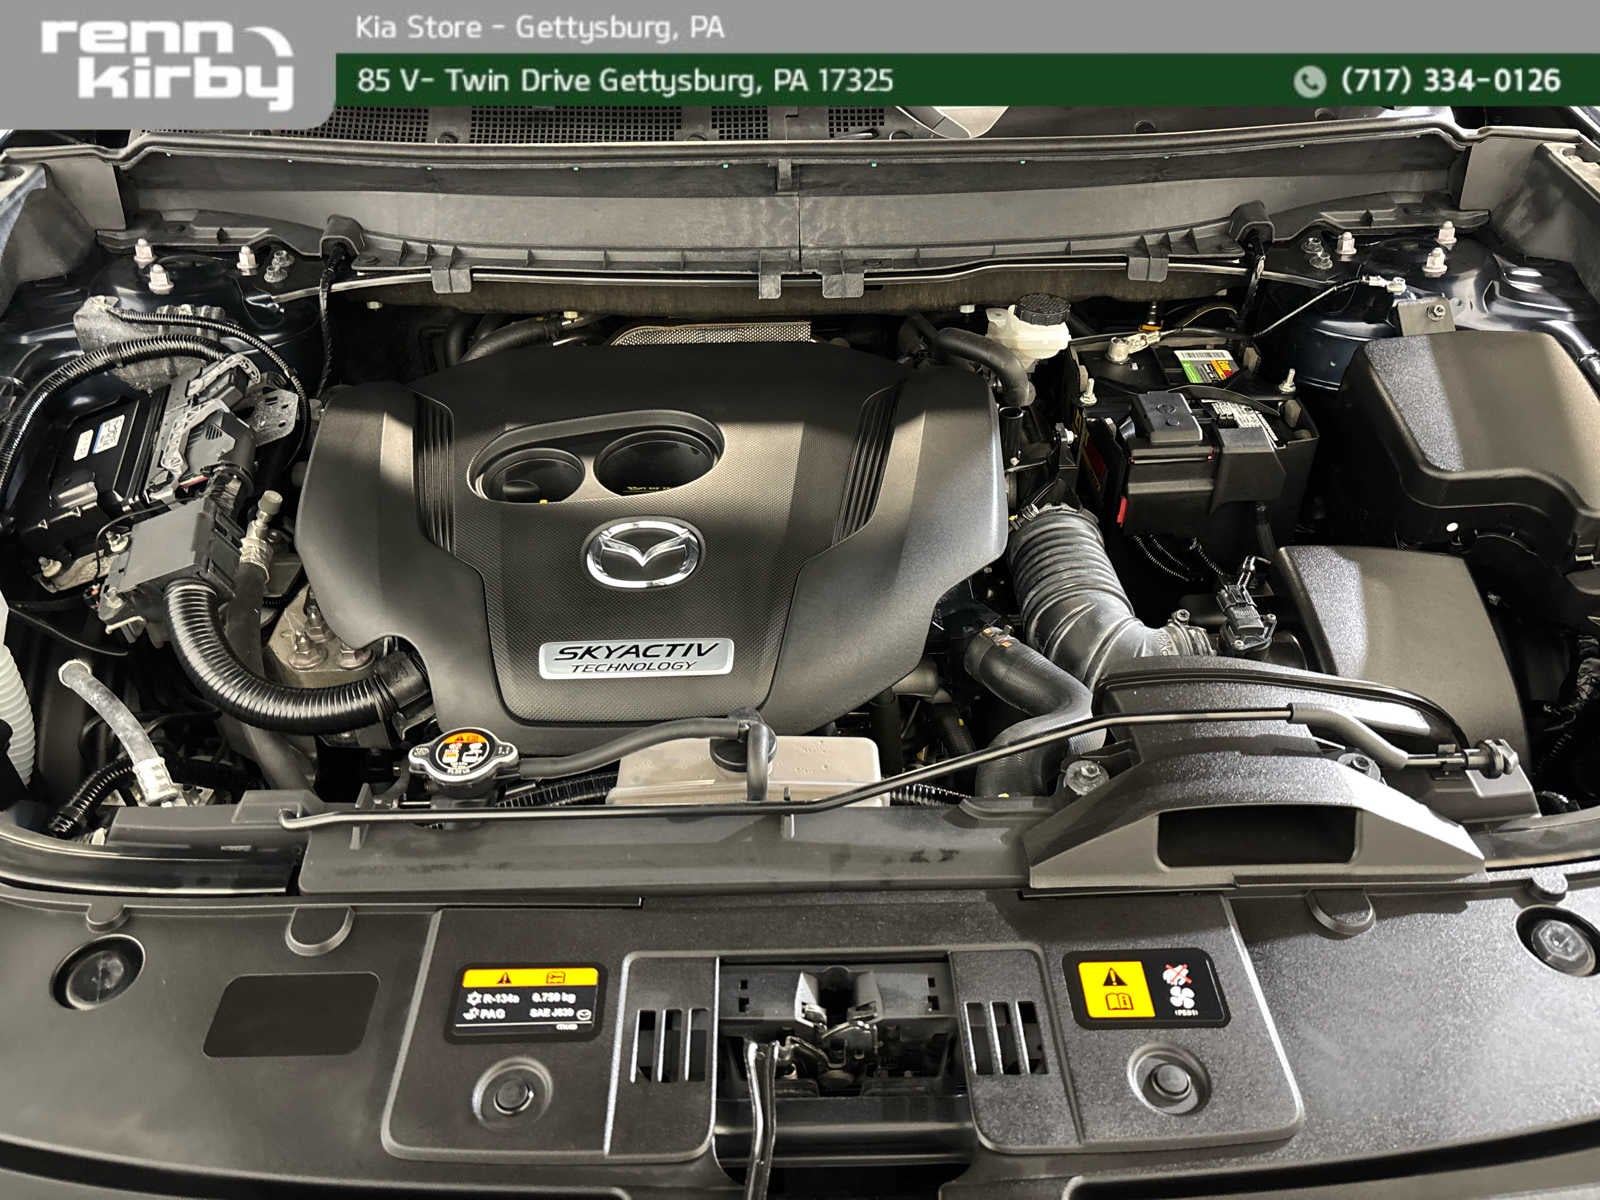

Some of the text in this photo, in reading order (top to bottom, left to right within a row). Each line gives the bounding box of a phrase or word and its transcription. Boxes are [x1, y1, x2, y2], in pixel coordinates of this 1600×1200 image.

[554, 642, 720, 661] SKYACTIV
[572, 661, 697, 673] TECHNOLOGY
[483, 993, 520, 1004] R-134a
